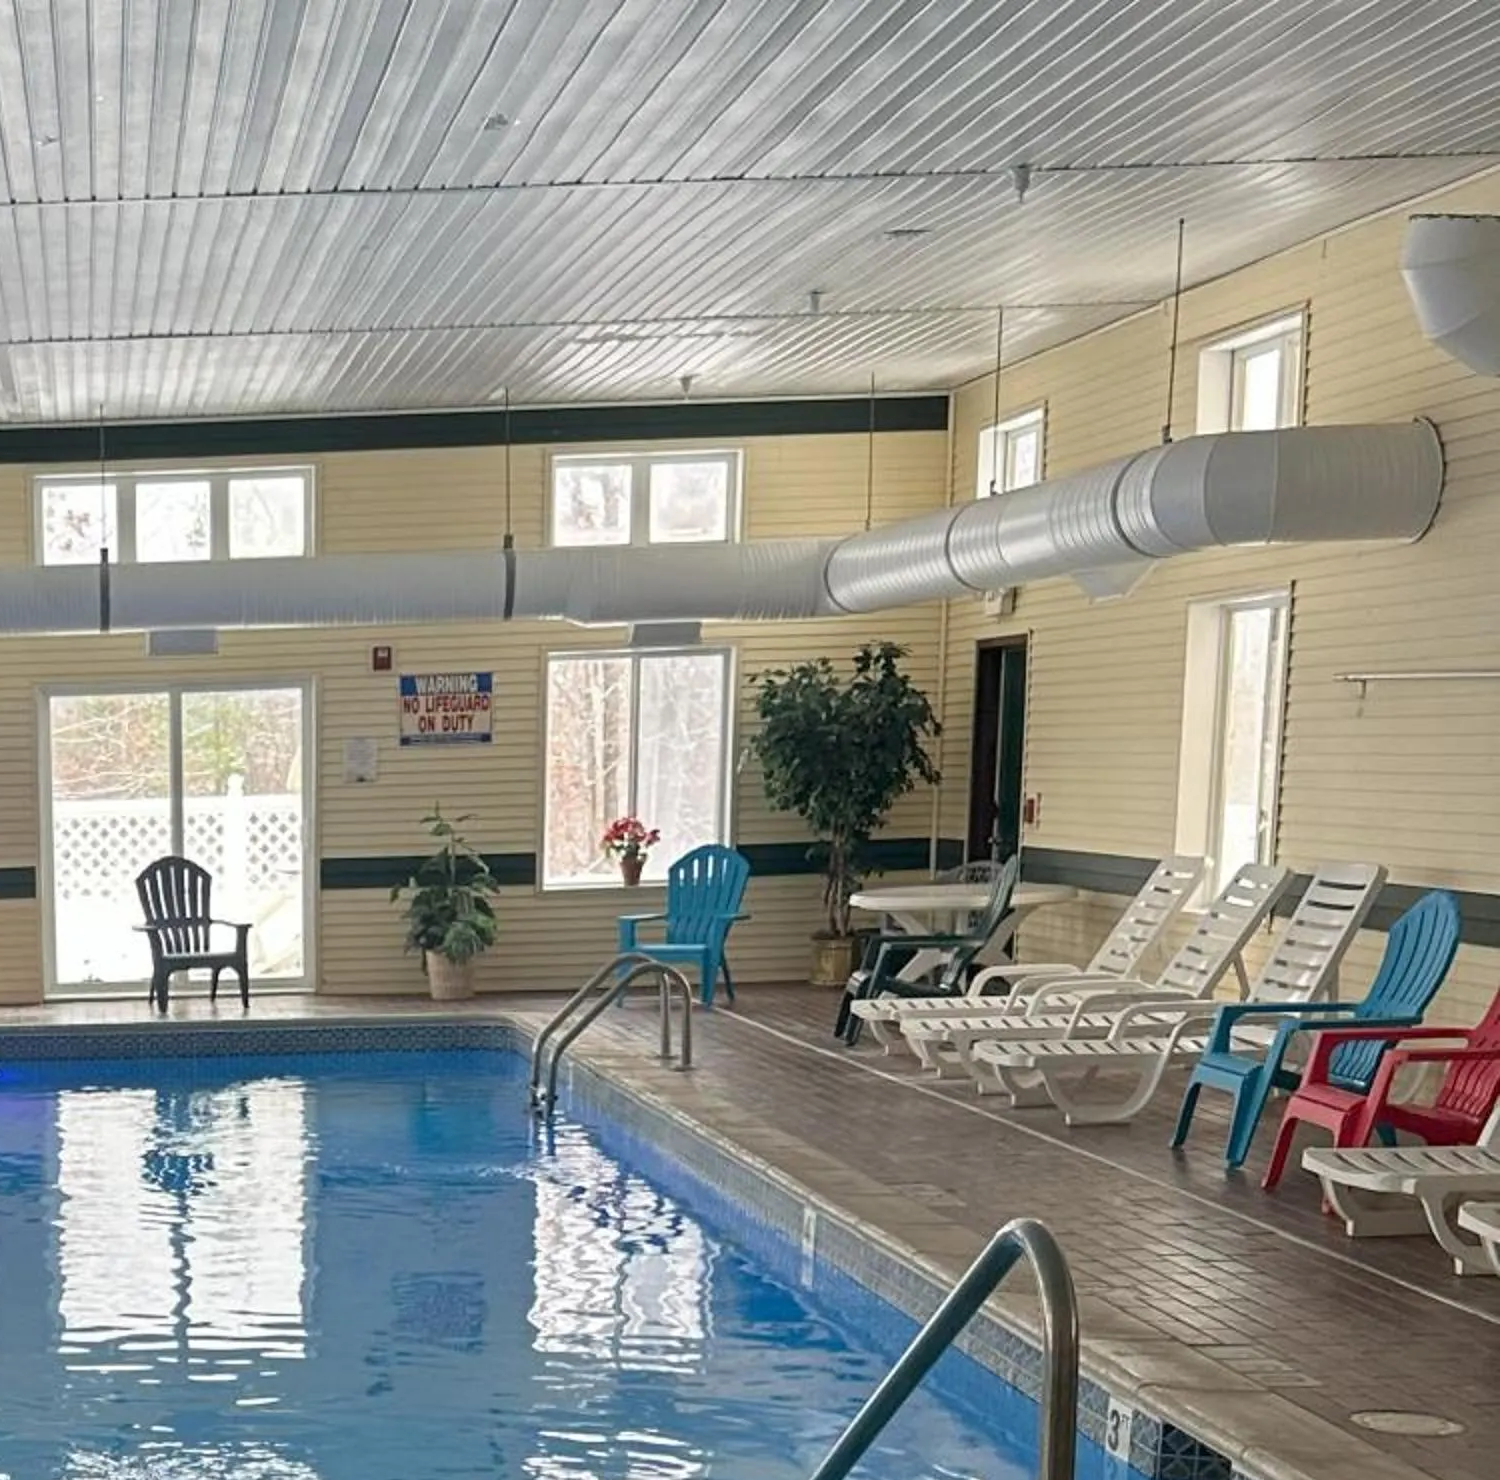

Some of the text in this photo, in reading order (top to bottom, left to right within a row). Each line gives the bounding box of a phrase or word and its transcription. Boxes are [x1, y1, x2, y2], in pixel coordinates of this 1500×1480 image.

[416, 674, 478, 694] WARNING
[403, 695, 489, 714] NO LIFEGUARD
[418, 714, 474, 732] ON DUTY
[1108, 1409, 1120, 1451] 3
